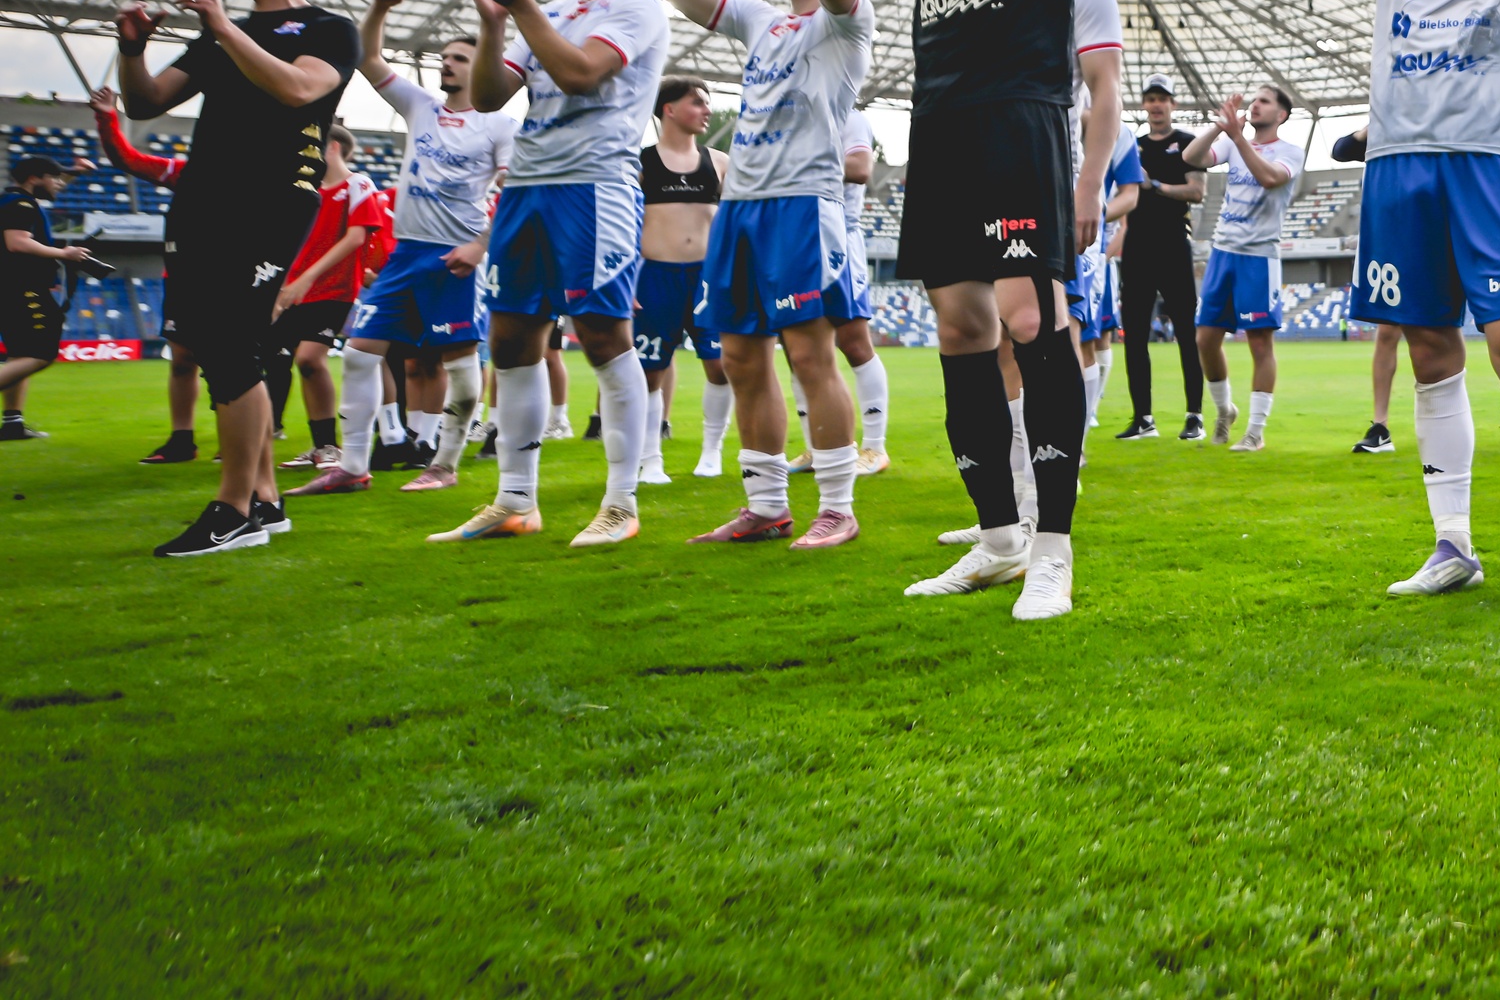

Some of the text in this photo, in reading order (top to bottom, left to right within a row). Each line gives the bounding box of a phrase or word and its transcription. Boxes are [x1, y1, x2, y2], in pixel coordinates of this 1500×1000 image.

[985, 218, 1037, 241] betters
[1367, 260, 1401, 307] 98
[775, 290, 821, 311] betters
[59, 342, 133, 360] tclic
[635, 334, 662, 361] 21
